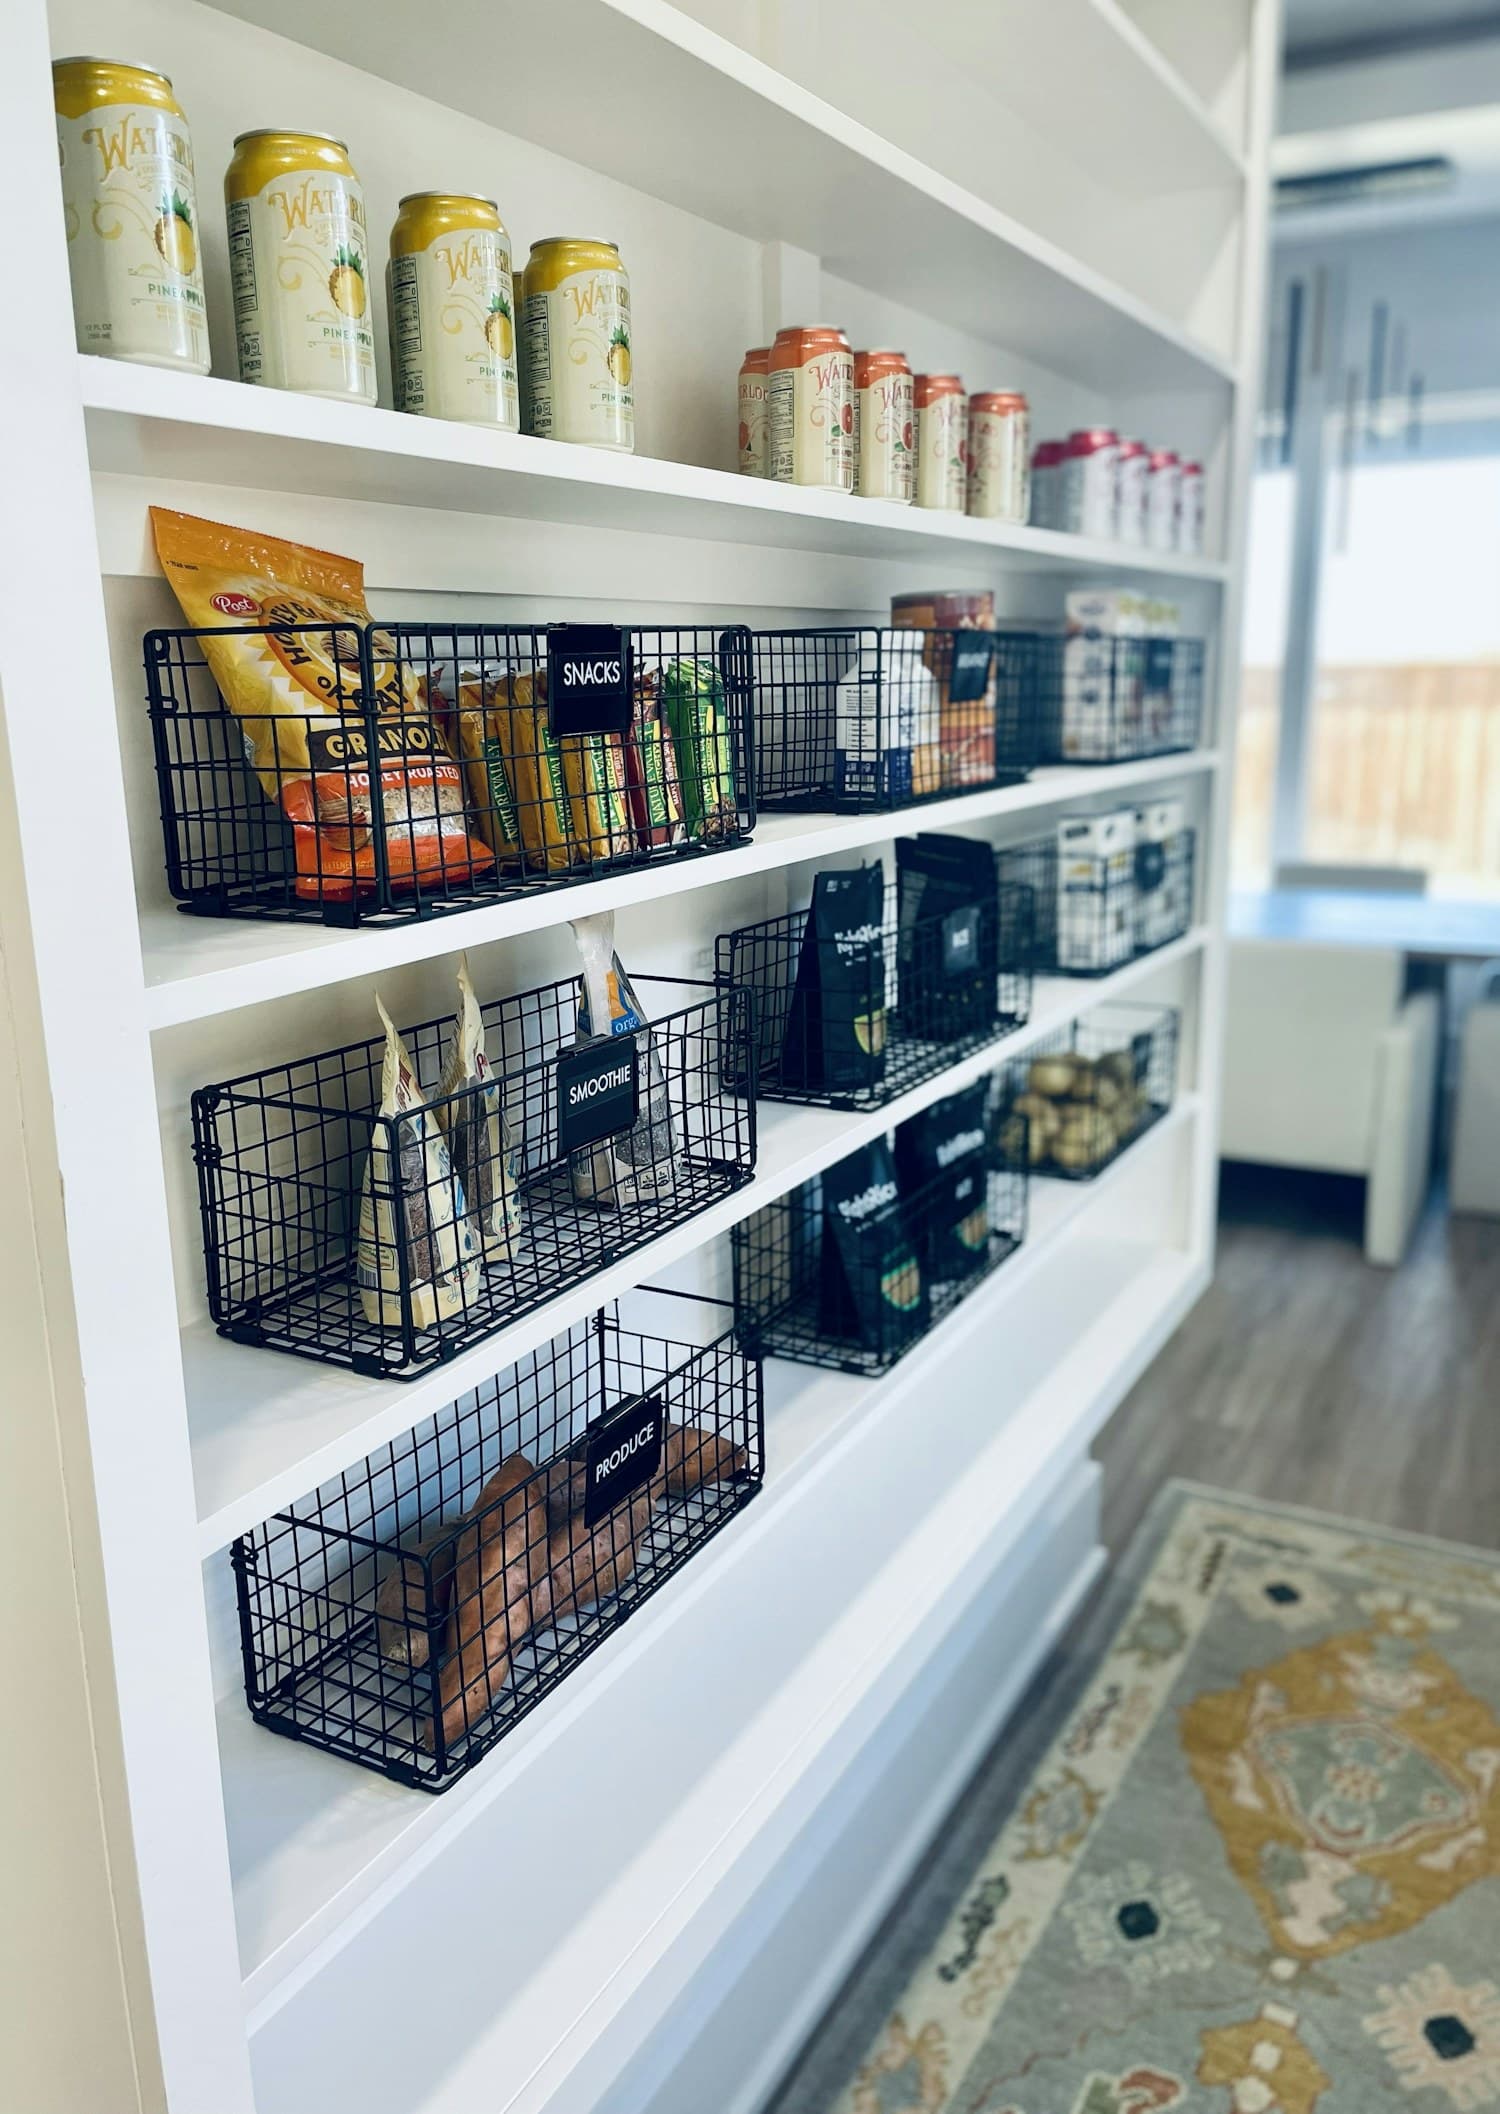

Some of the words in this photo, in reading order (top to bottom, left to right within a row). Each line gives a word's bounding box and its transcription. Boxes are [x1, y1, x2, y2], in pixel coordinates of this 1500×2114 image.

[215, 595, 253, 613] Post
[563, 660, 621, 686] SNACKS
[343, 771, 401, 788] HOEY
[407, 766, 460, 780] ROASTED
[569, 1064, 631, 1105] SMOOTHIE
[596, 1421, 655, 1484] PRODUCE
